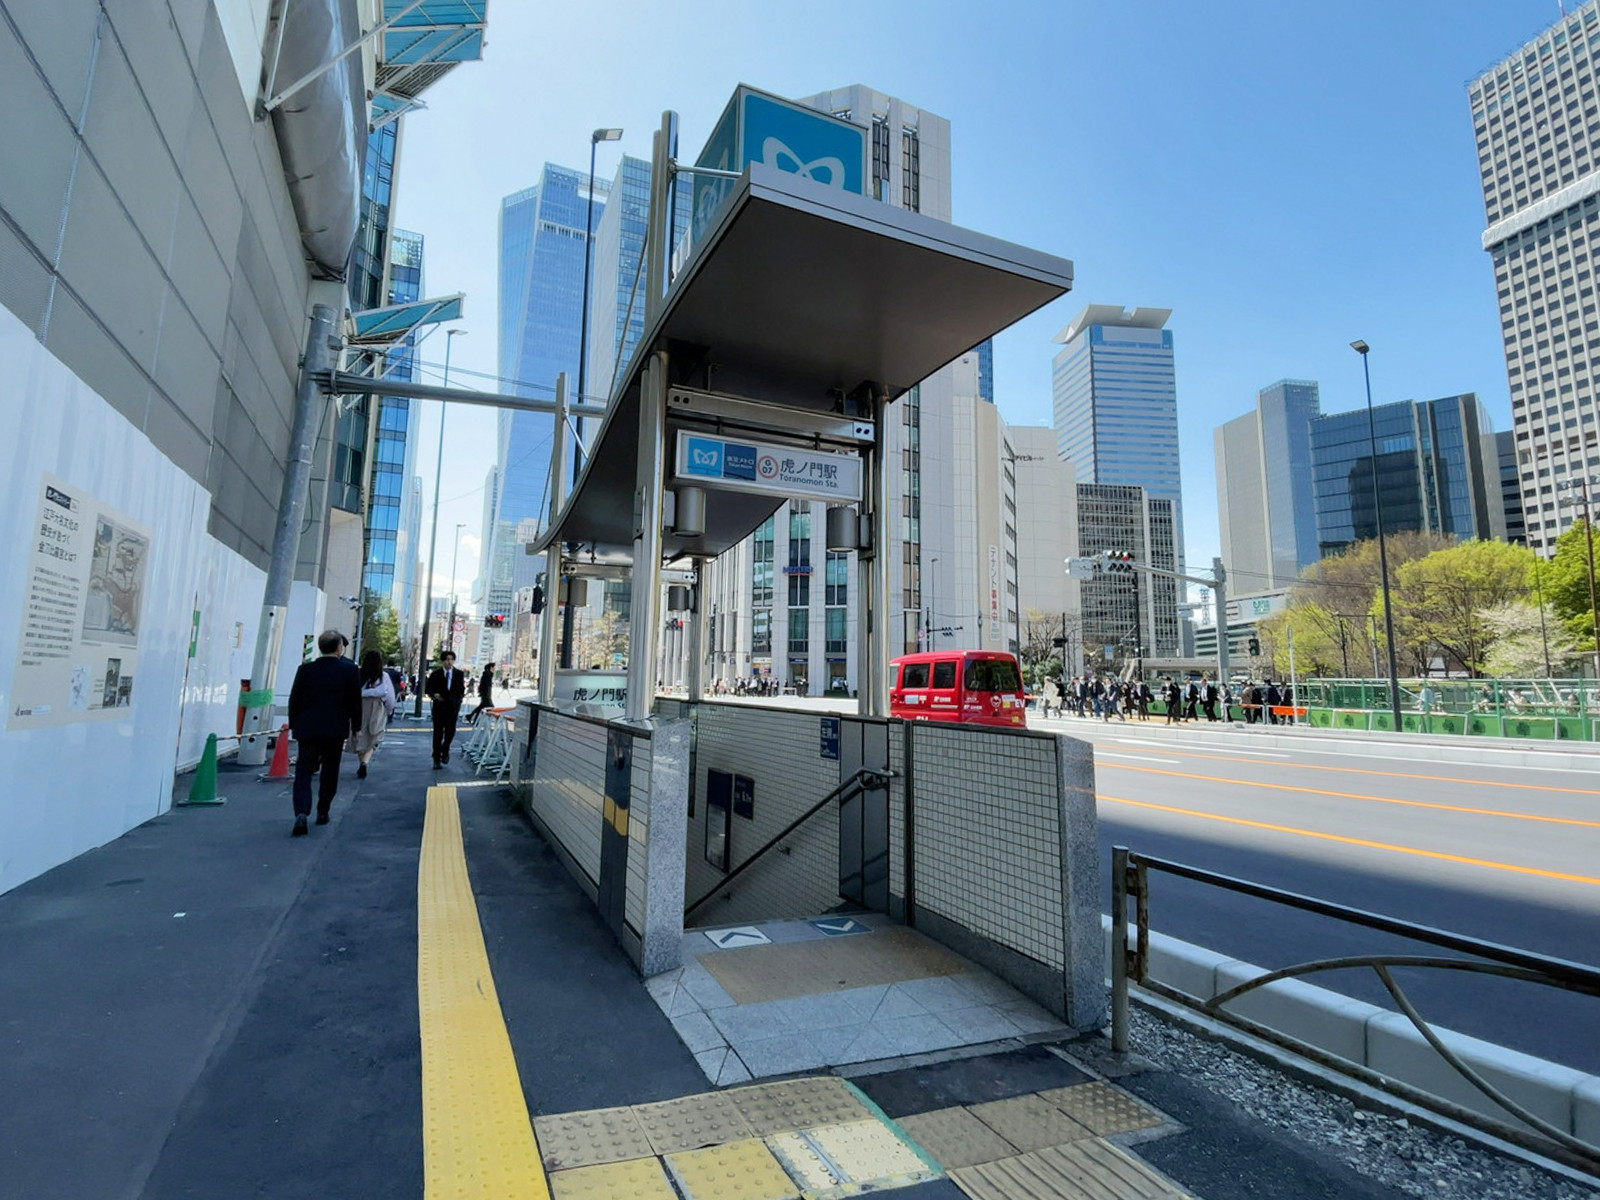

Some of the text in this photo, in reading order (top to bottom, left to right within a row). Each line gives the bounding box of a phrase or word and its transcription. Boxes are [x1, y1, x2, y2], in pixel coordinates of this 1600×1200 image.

[762, 467, 773, 475] 07
[780, 458, 838, 480] 虎ノ門駅
[779, 473, 839, 489] Toranomon Sta.
[573, 688, 627, 701] 虎ノ門駅
[1014, 698, 1026, 708] EV
